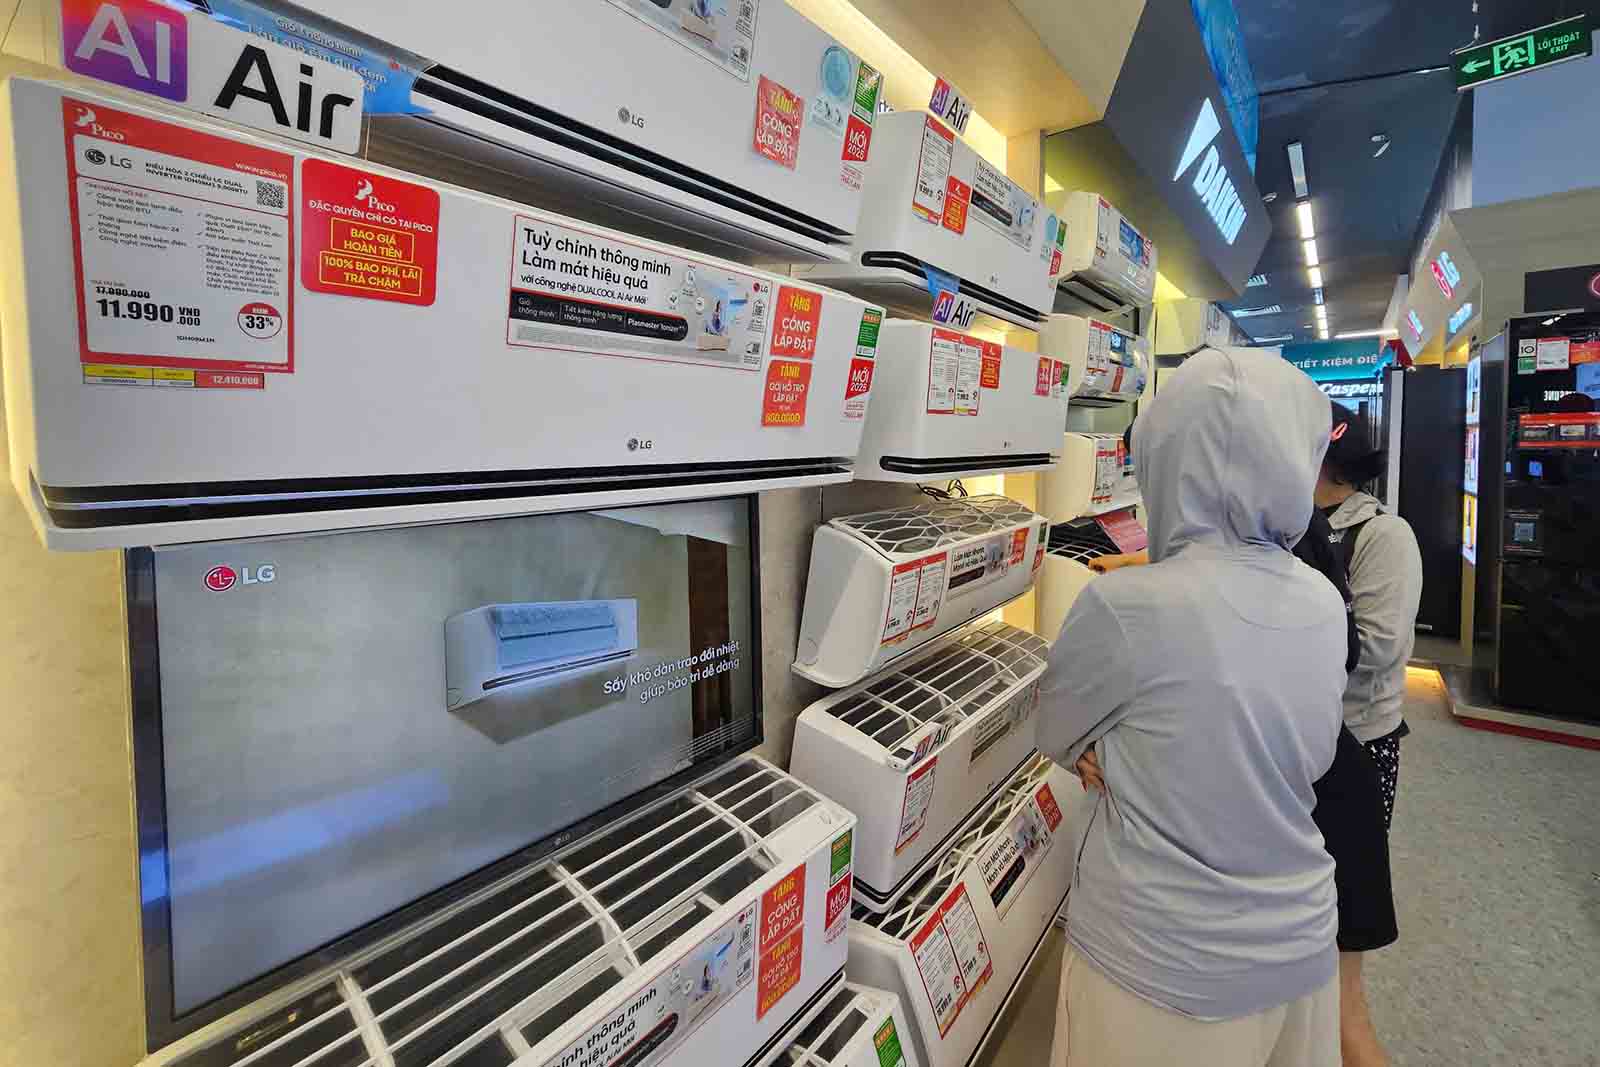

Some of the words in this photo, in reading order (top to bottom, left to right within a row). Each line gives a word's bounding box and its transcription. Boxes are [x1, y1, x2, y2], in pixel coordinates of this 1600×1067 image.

[1550, 44, 1568, 54] EXIT
[74, 2, 170, 84] AI
[213, 42, 354, 140] Air
[632, 115, 644, 128] LG
[946, 96, 968, 130] Air
[92, 124, 124, 141] Pico
[848, 143, 864, 160] 2025
[110, 155, 132, 169] LG
[146, 169, 182, 182] INVERTER
[368, 195, 395, 212] Pico
[1192, 145, 1248, 245] DAIKIN
[334, 204, 365, 220] QUYỀN
[382, 214, 397, 224] CÓ
[413, 223, 433, 232] PICO
[351, 228, 374, 240] BAO
[376, 232, 397, 245] GIÁ
[344, 240, 377, 254] HOÀN
[380, 246, 402, 258] TIỀN
[324, 256, 352, 270] 100%
[355, 260, 380, 273] BAO
[402, 268, 418, 280] LÃI
[522, 250, 556, 271] Làm
[560, 260, 589, 278] mát
[592, 266, 620, 286] hiệu
[624, 275, 648, 290] quả
[600, 247, 640, 272] thông
[642, 259, 671, 276] minh
[344, 270, 366, 284] TRẢ
[368, 276, 400, 290] CHẬM
[520, 274, 534, 284] với
[534, 276, 556, 290] công
[556, 280, 577, 294] nghệ
[577, 284, 616, 299] DUALCOOL
[760, 285, 768, 294] LG
[96, 298, 174, 323] 11.990
[934, 300, 954, 322] AI
[951, 300, 974, 327] Air
[782, 315, 811, 333] CÔNG
[774, 334, 794, 348] LẮP
[794, 336, 814, 353] ĐẶT
[1294, 357, 1319, 368] TIẾT
[852, 367, 869, 383] MỚI
[850, 382, 867, 392] 2025
[640, 440, 652, 449] LG
[241, 564, 276, 584] LG
[602, 675, 627, 694] Sấy
[630, 671, 652, 688] khô
[654, 662, 674, 677] dàn
[677, 655, 698, 670] trao
[700, 647, 716, 662] đổi
[716, 640, 740, 658] nhiệt
[640, 684, 664, 704] giúp
[667, 676, 688, 690] bảo
[702, 663, 716, 678] dễ
[716, 658, 740, 674] dàng
[929, 724, 952, 752] Air
[767, 896, 798, 924] CÔNG
[762, 921, 782, 945] LẮP
[782, 906, 802, 930] ĐẶT
[586, 1013, 625, 1049] thông
[628, 988, 657, 1016] minh
[611, 1018, 636, 1045] quả
